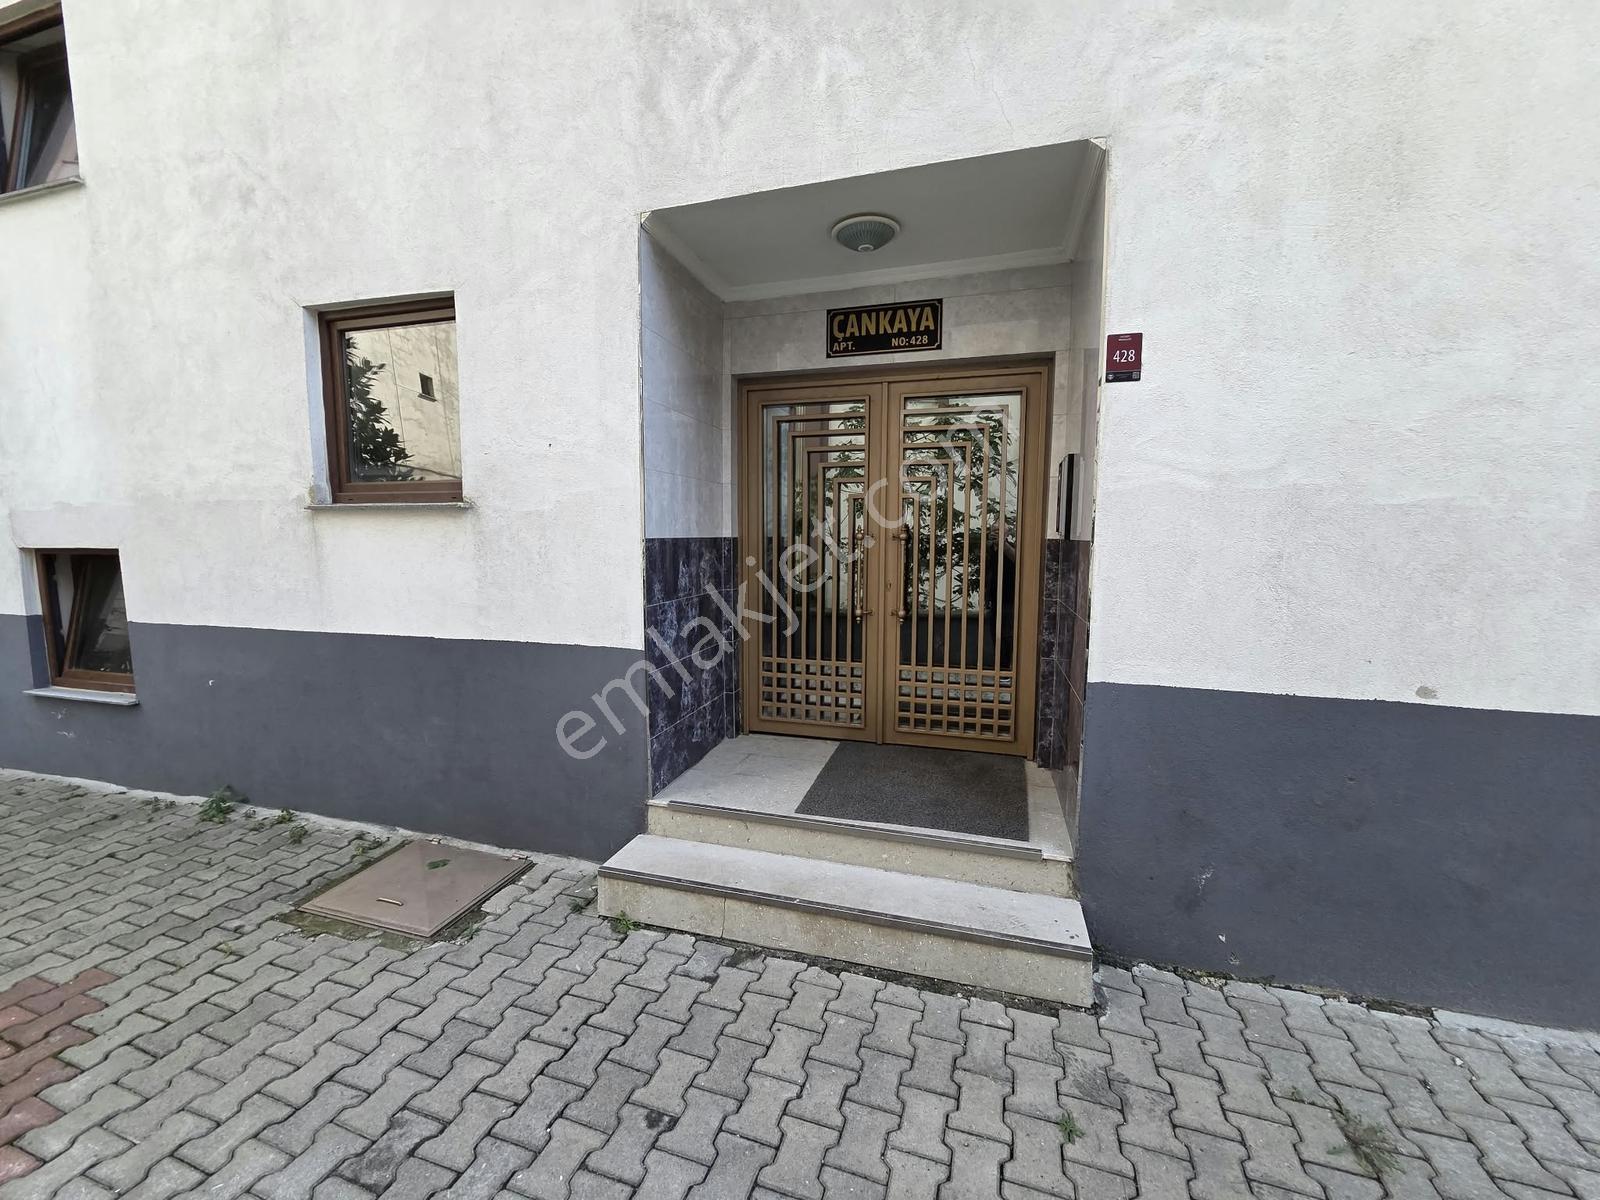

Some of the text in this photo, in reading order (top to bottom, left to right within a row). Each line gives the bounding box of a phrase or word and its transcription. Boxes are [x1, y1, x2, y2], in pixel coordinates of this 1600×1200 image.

[833, 306, 935, 342] ÇANKAYA
[833, 335, 928, 352] APT. NO:428
[1113, 349, 1136, 363] 428
